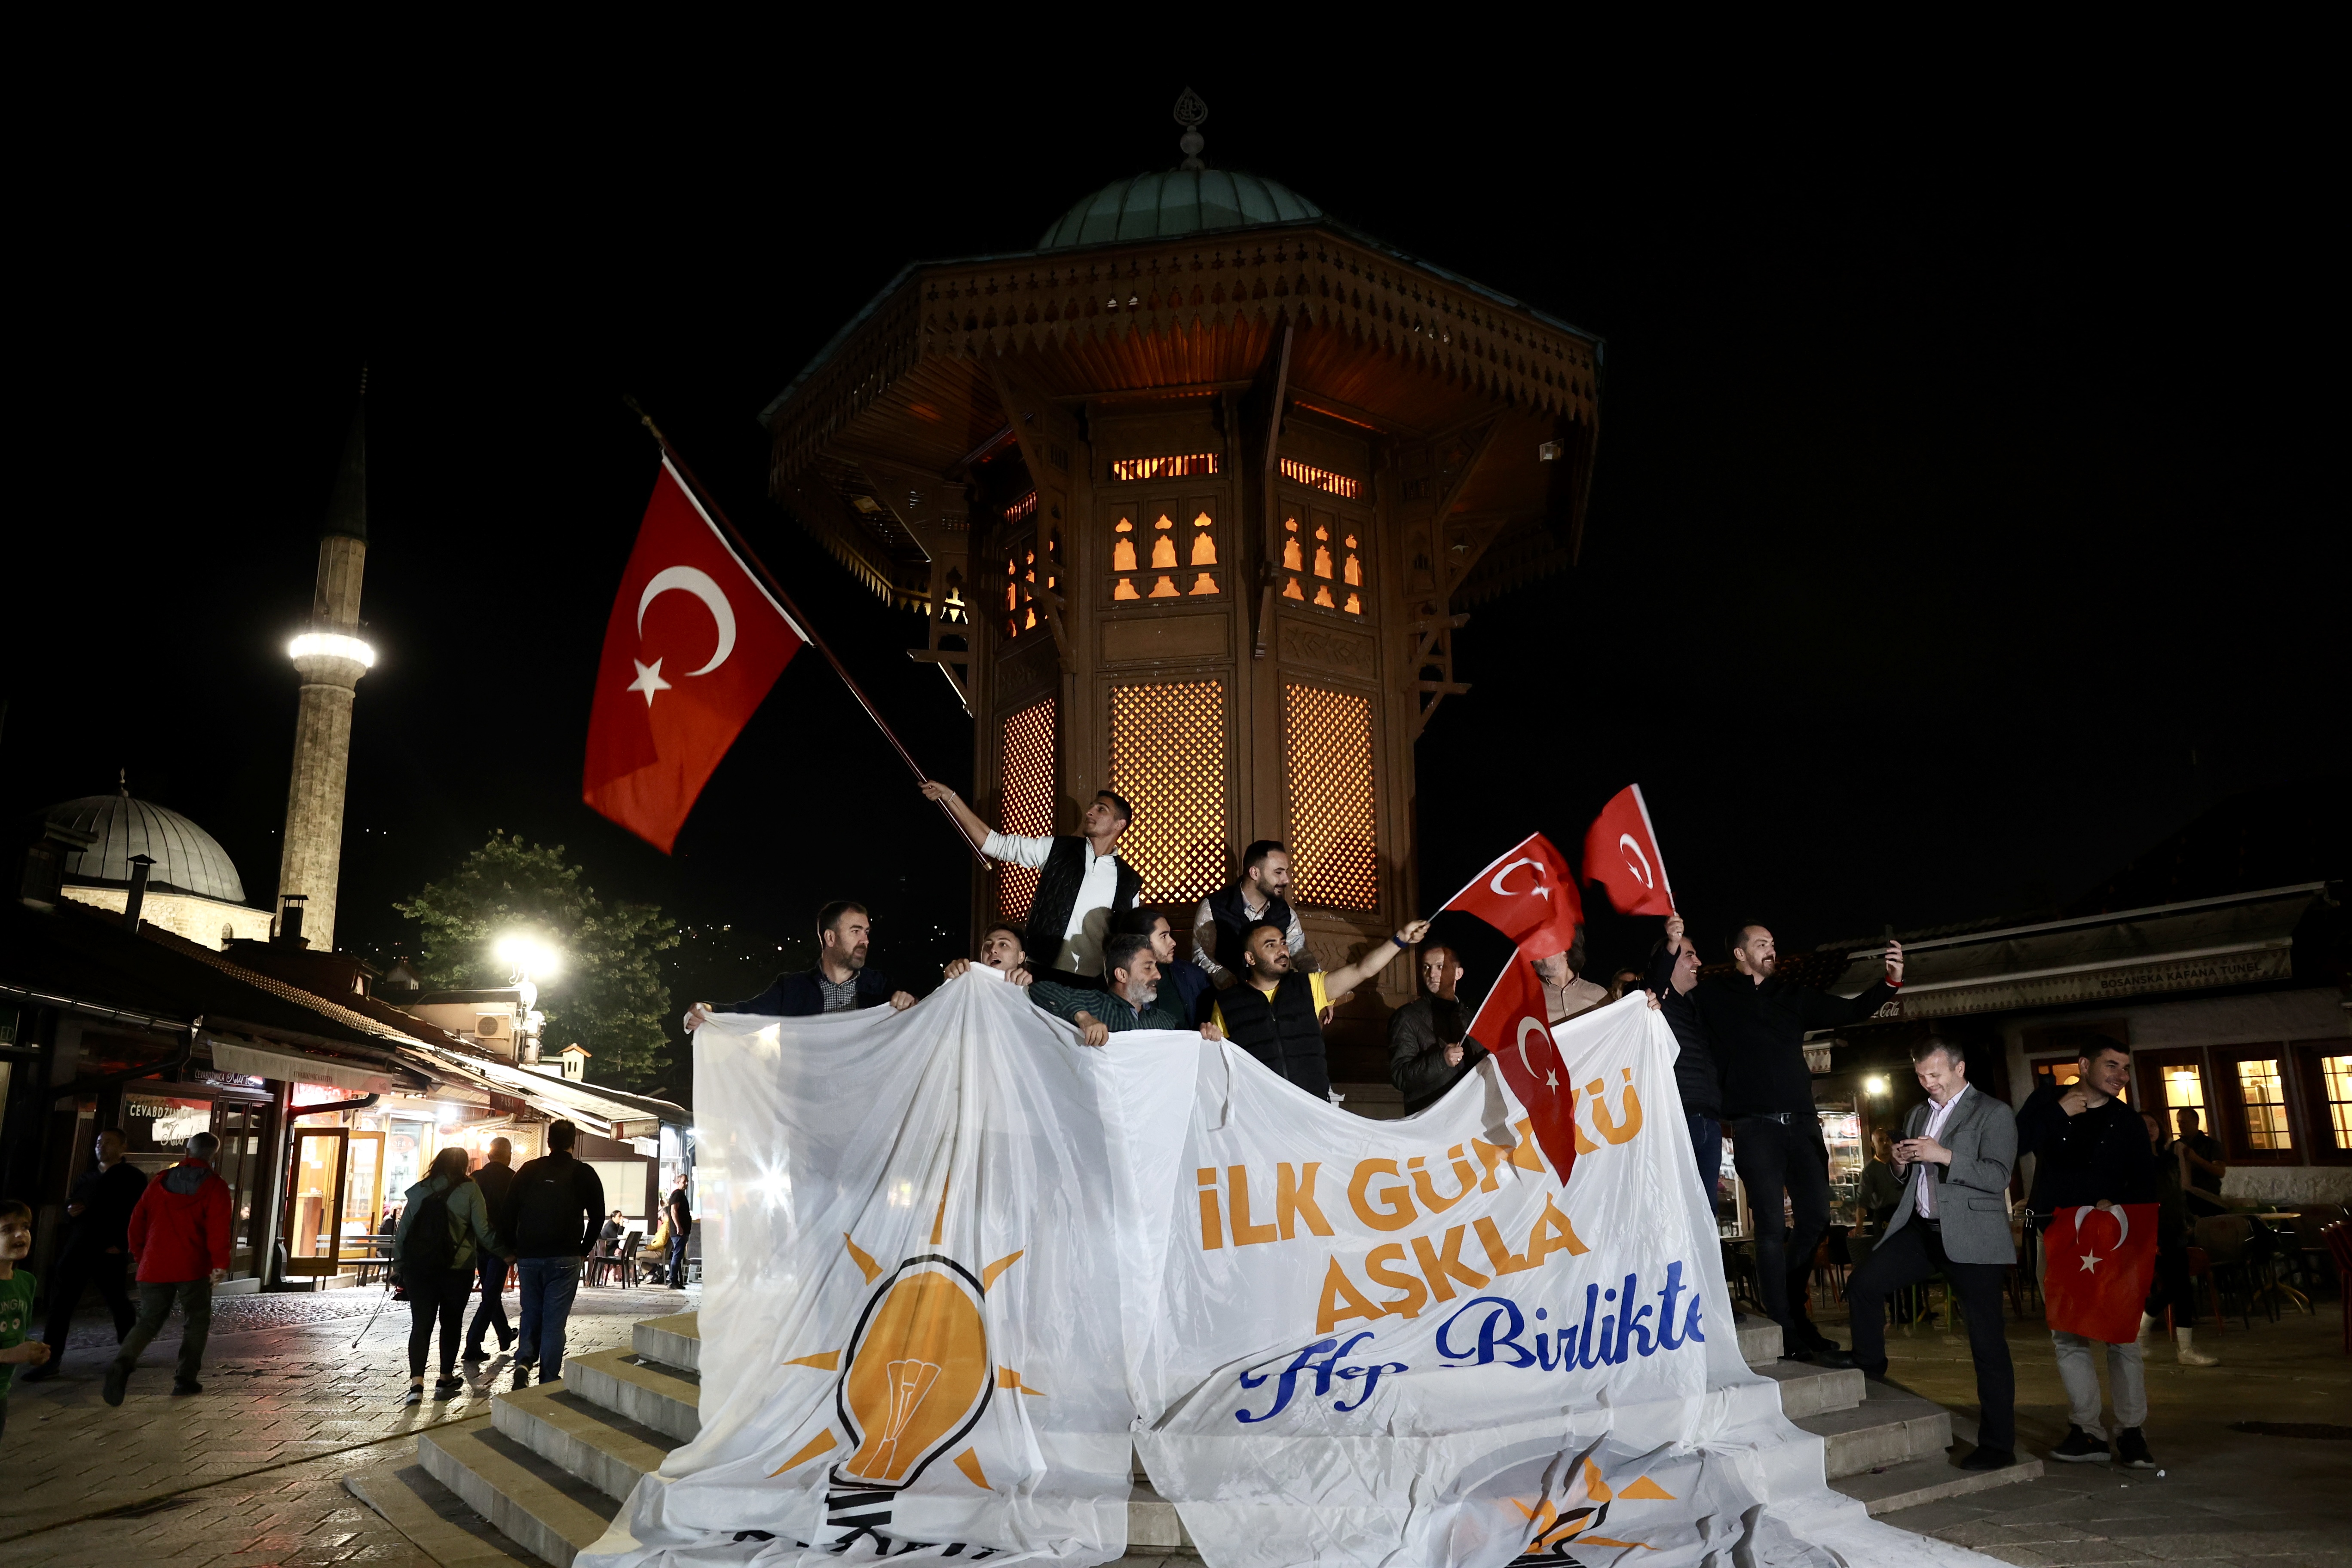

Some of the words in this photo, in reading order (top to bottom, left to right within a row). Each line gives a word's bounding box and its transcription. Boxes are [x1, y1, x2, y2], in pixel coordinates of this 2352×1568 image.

[2101, 973, 2164, 989] BOSANSKA
[2167, 968, 2217, 981] KAFANA
[2220, 962, 2262, 975] TUNEL
[1872, 1001, 1900, 1018] Cola
[160, 1123, 193, 1146] Kurt
[1316, 1192, 1590, 1335] AŞKLA
